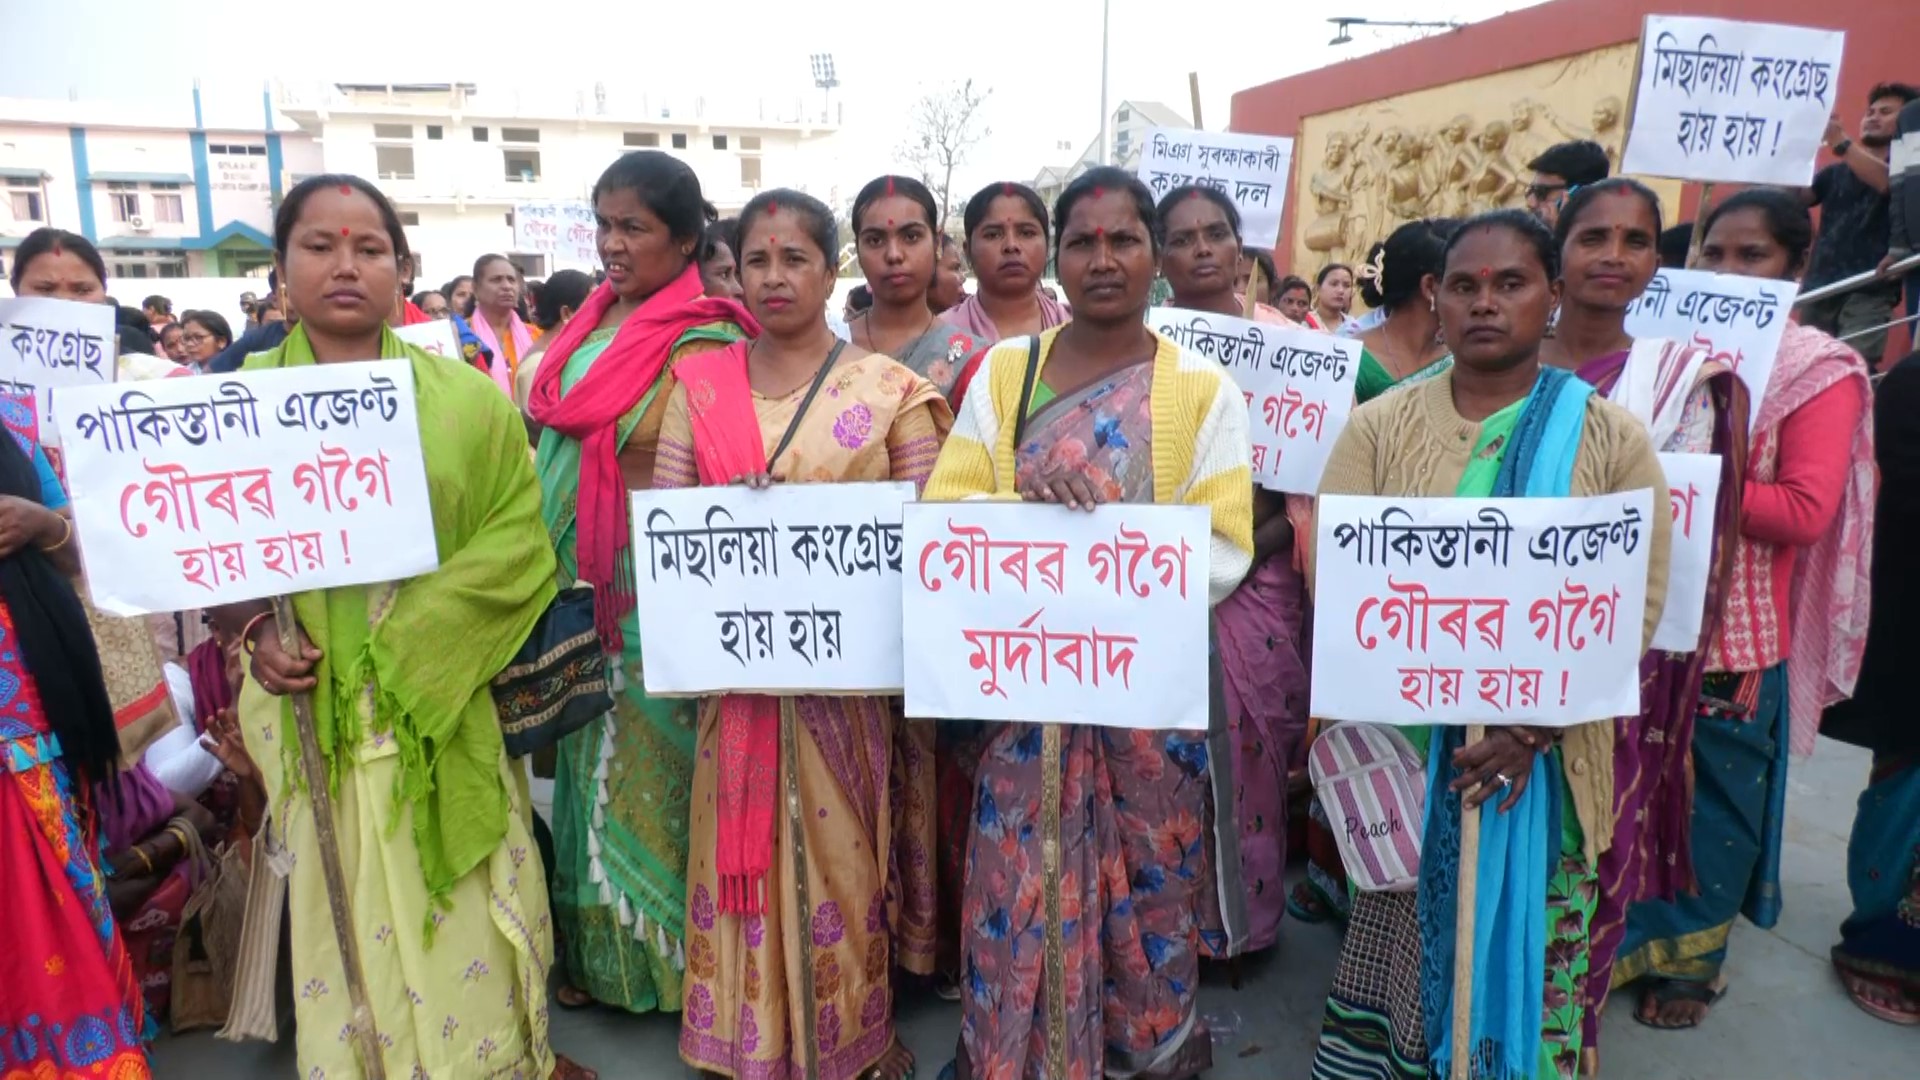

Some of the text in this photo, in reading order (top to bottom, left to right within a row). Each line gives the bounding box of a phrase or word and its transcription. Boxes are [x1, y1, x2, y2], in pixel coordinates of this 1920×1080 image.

[1653, 31, 1744, 98] মিছলিয়া
[1677, 107, 1717, 159] হায়
[1722, 112, 1766, 160] হায়
[1235, 180, 1271, 208] দল
[1676, 287, 1777, 329] এজেণ্ট
[1271, 344, 1349, 382] এজেণ্ট
[76, 372, 397, 453] পাকিস্তানী এজেণ্ট
[1263, 383, 1327, 442] গগৈ
[120, 441, 392, 538] গৌৰৱ গগৈ
[174, 541, 246, 592] হায়
[256, 530, 324, 579] হায়
[644, 505, 778, 586] মিছলিয়া
[919, 517, 1192, 600] গৌৰৱ গগৈ
[1333, 507, 1514, 568] পাকিস্তানী
[1528, 503, 1642, 566] এজেণ্ট
[715, 602, 841, 667] হায় হায়
[1356, 574, 1620, 653] গৌৰৱ গগৈ
[1397, 663, 1463, 710] হায়
[1476, 663, 1543, 711] হায়
[1344, 808, 1401, 843] Peach
